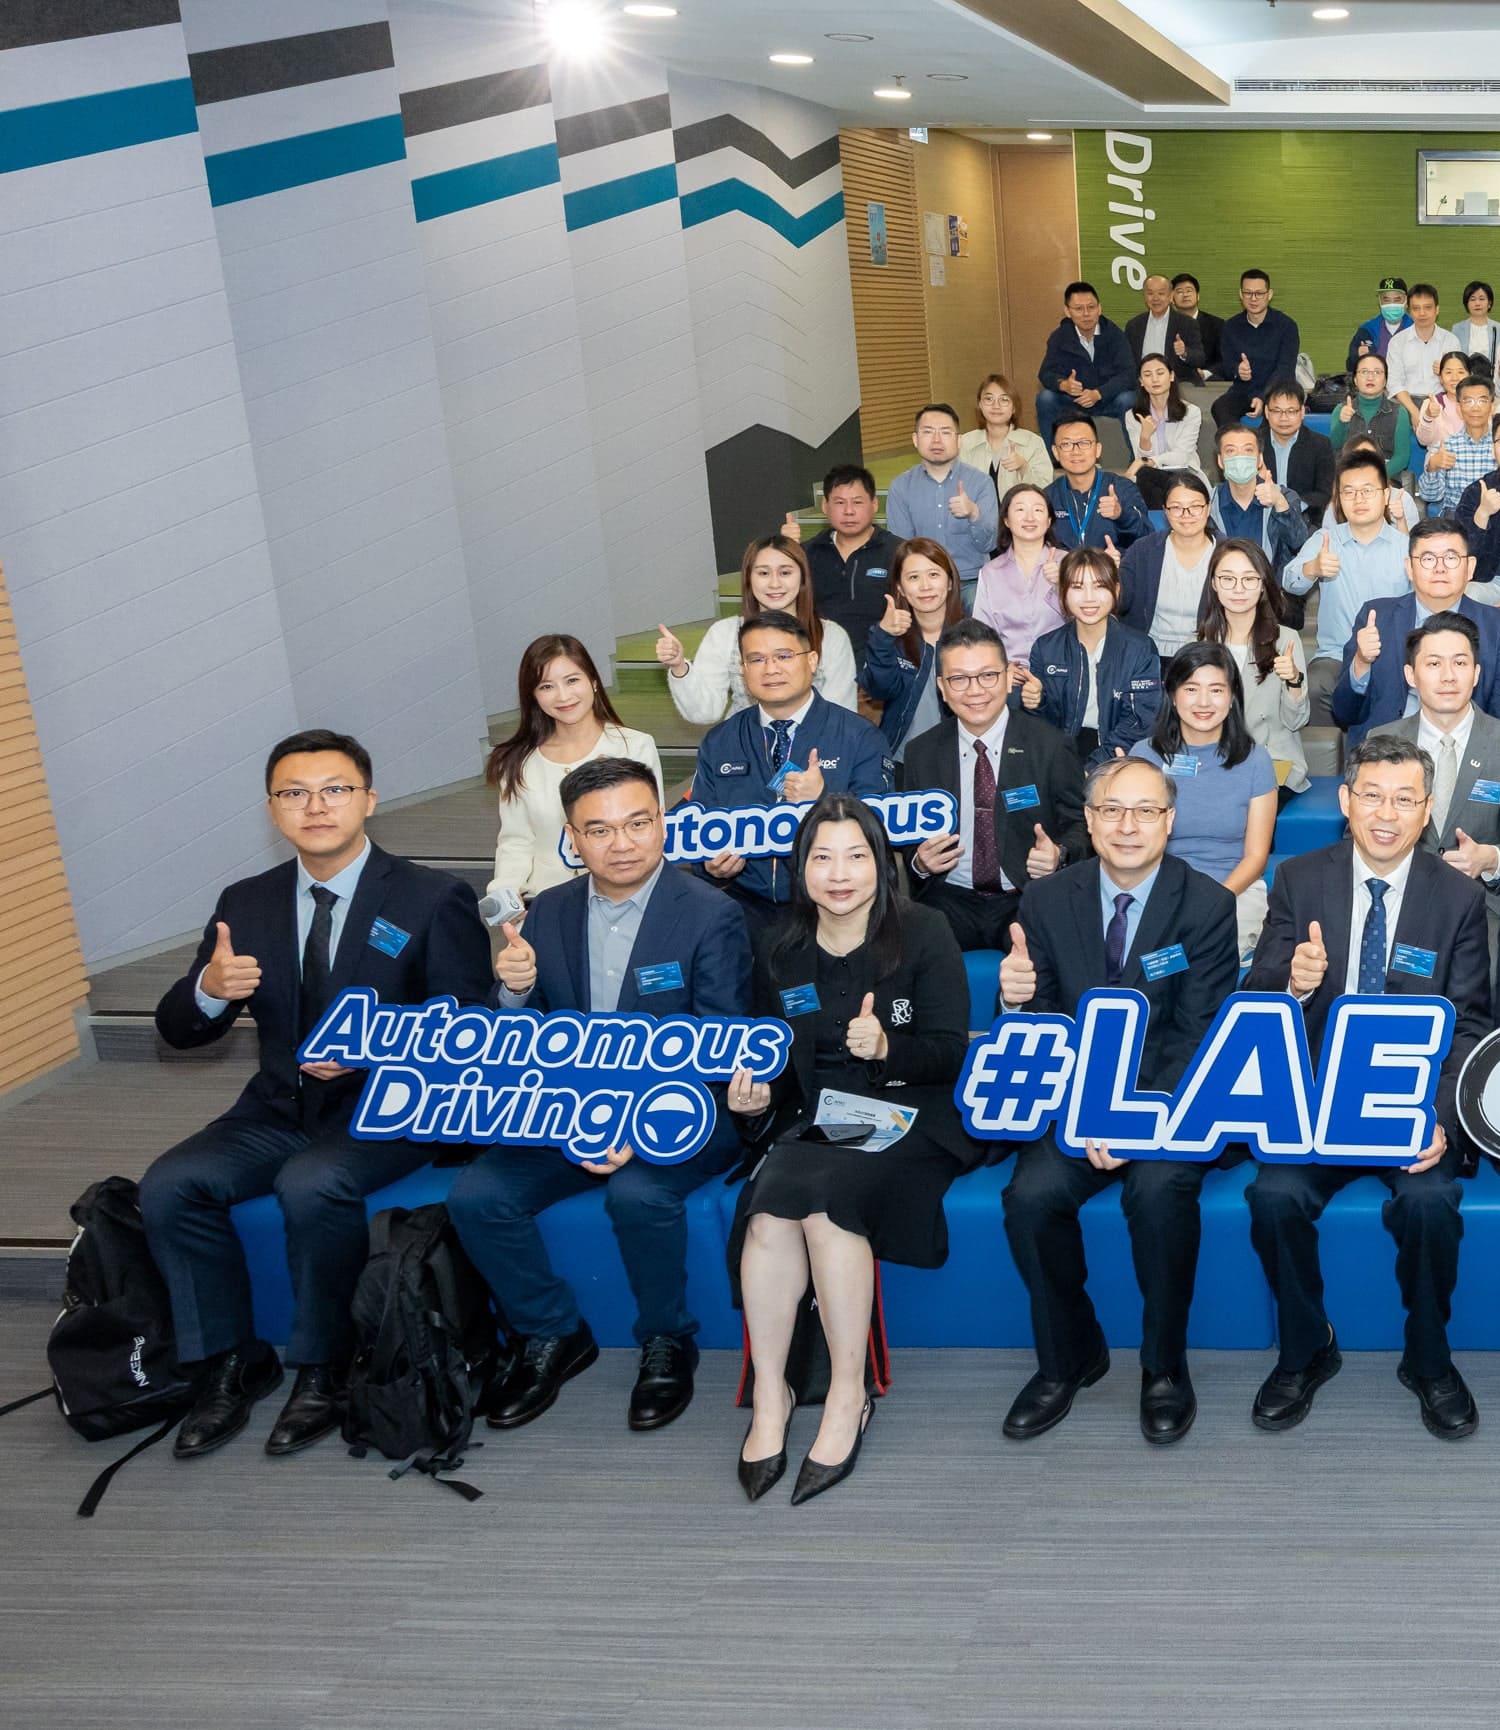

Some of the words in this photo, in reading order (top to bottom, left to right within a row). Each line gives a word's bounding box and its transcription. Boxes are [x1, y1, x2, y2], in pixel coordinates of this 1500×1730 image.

[1105, 130, 1156, 291] Drive
[574, 800, 946, 857] tonous
[308, 993, 782, 1076] Autonomous
[972, 1003, 1439, 1155] #LAE
[357, 1067, 631, 1160] Driving
